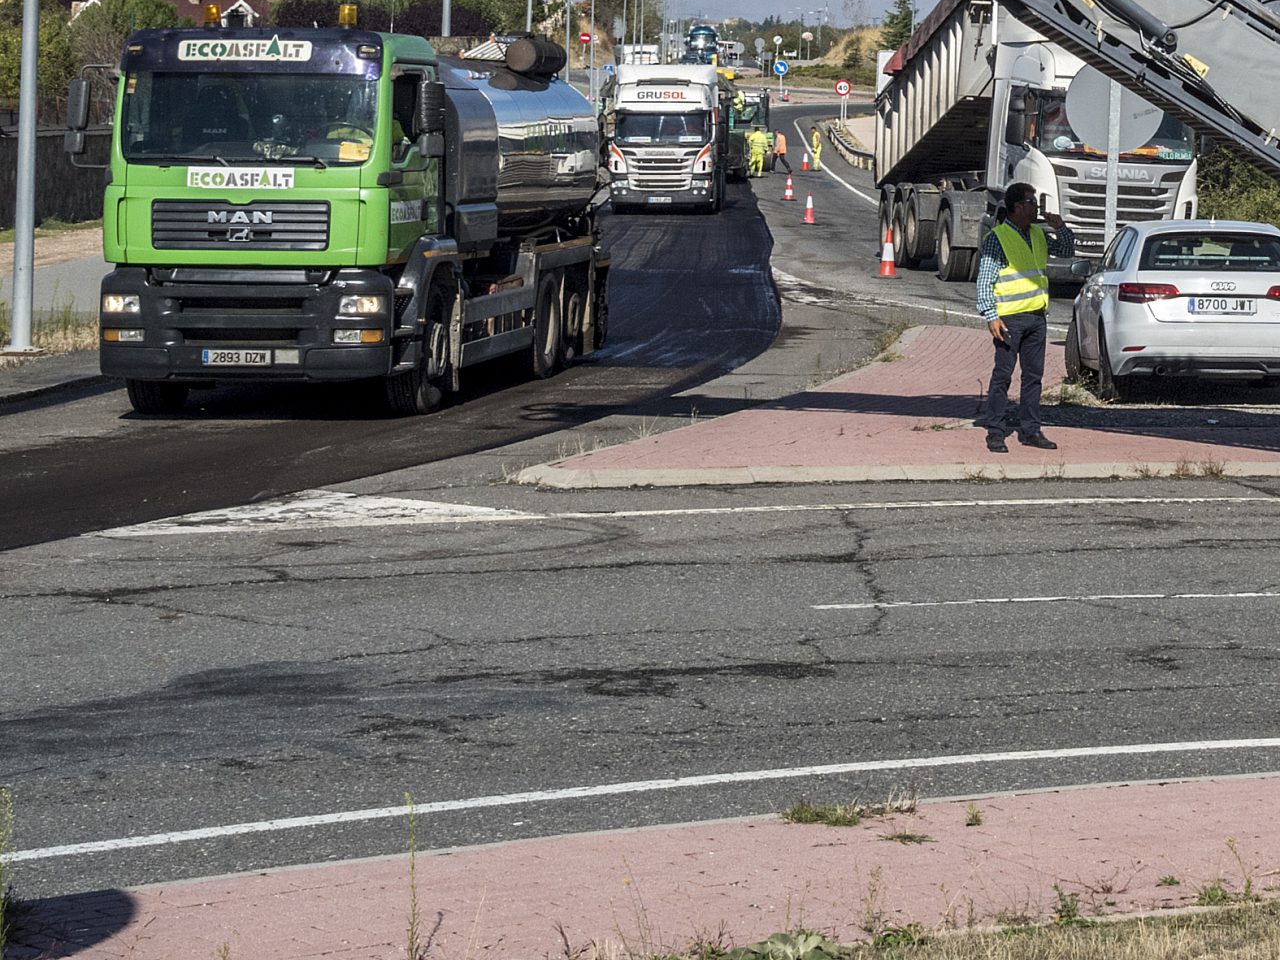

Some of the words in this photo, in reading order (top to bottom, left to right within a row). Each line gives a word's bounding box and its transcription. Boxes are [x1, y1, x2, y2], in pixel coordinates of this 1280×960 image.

[186, 38, 304, 58] ECOASFALT
[637, 91, 687, 100] GRUSOL
[190, 169, 292, 187] ECOASFALT
[208, 211, 272, 224] MAN
[1197, 299, 1228, 310] 8700
[1232, 299, 1253, 311] JWT
[212, 352, 240, 363] 2893
[245, 352, 266, 363] DZW
